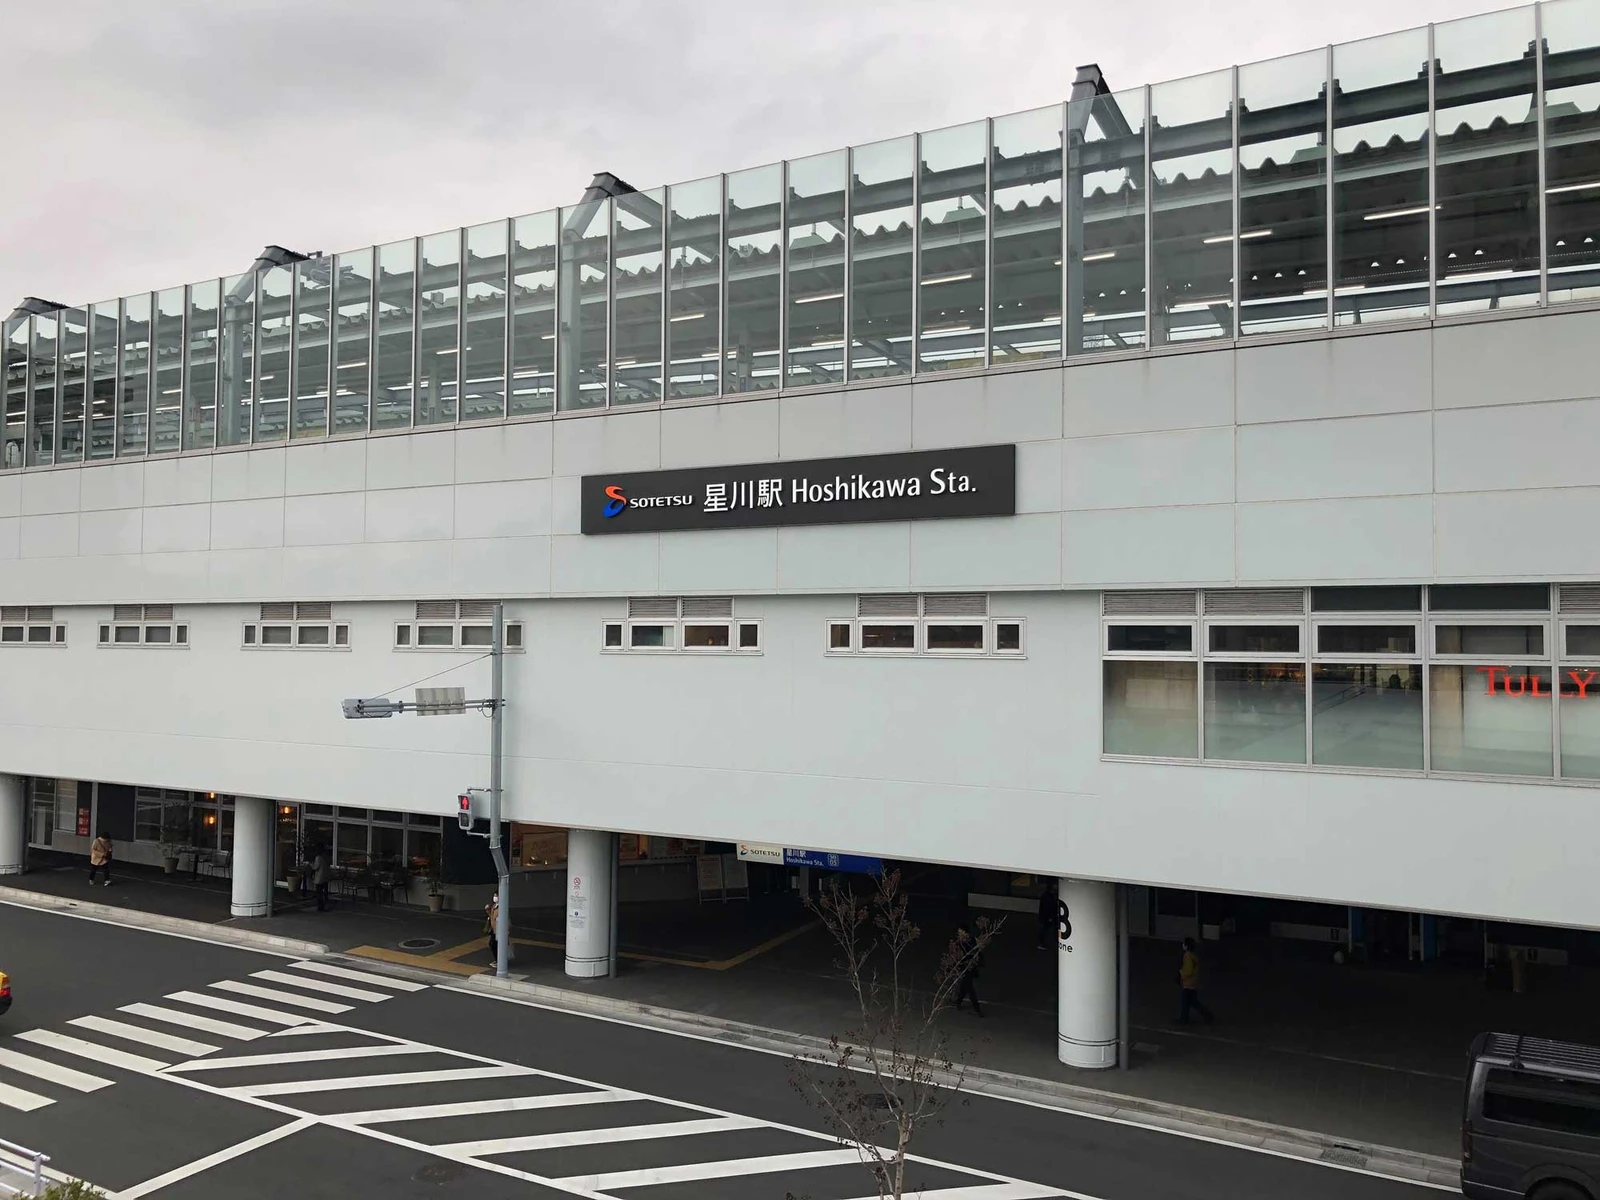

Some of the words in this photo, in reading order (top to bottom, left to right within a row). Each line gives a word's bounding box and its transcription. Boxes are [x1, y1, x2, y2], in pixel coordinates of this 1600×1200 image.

[629, 495, 693, 509] SOTETSU
[703, 479, 784, 513] 星川駅
[792, 475, 921, 504] Hoshikawa
[930, 467, 977, 495] Sta.
[750, 848, 781, 857] SOTETSU
[786, 857, 813, 865] Hoshikawa
[1058, 941, 1073, 952] one
